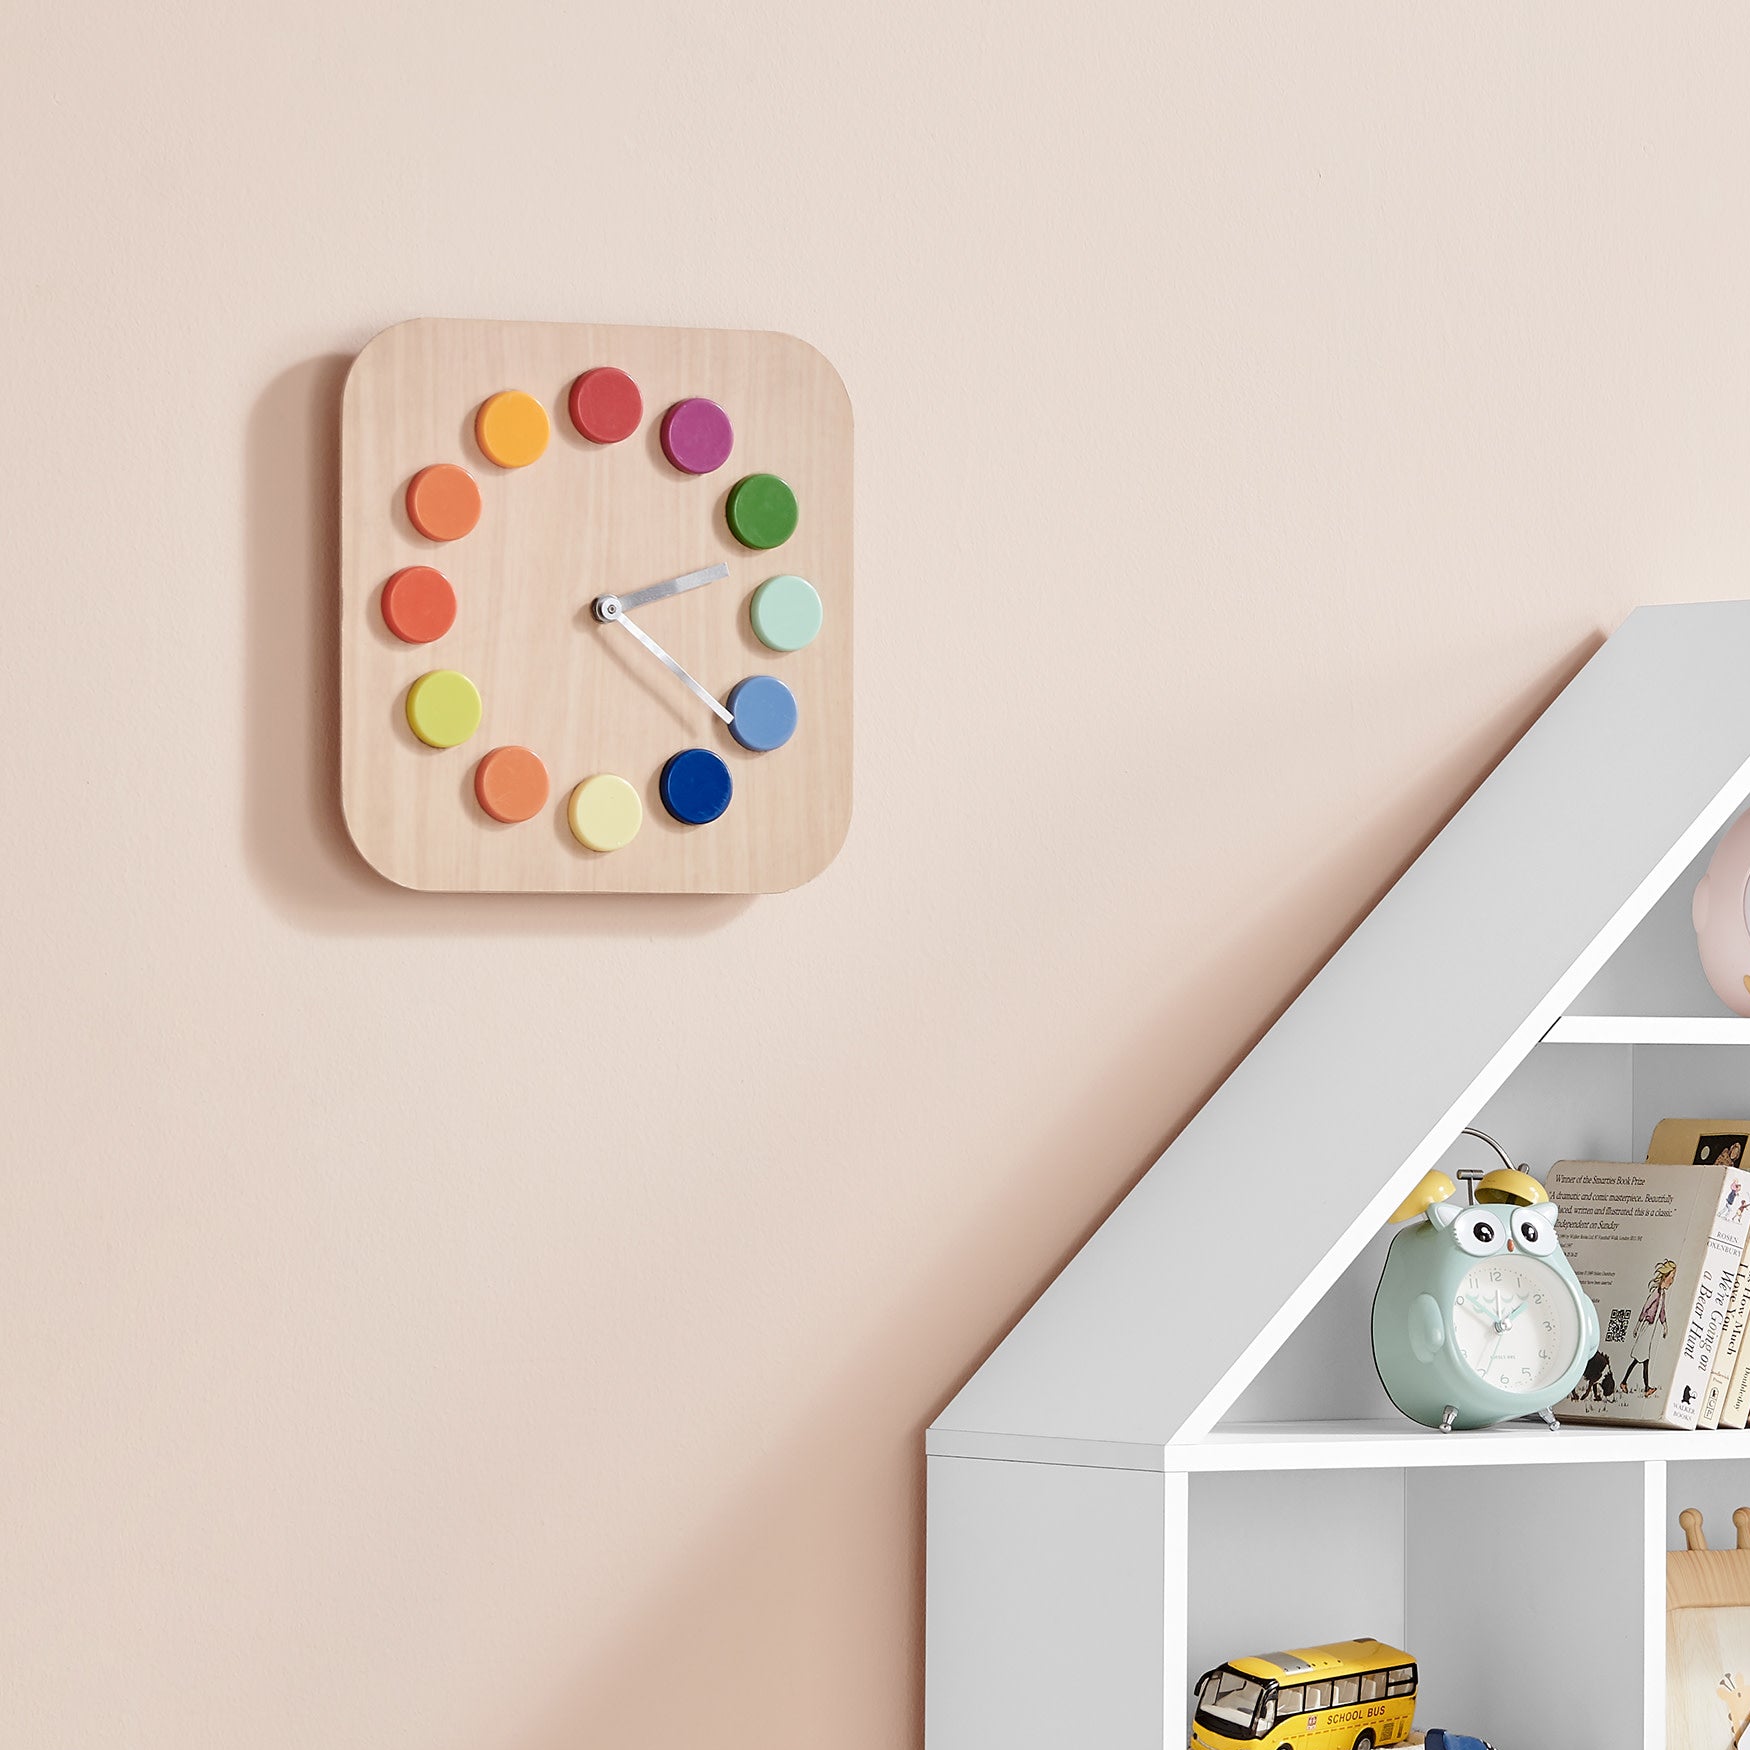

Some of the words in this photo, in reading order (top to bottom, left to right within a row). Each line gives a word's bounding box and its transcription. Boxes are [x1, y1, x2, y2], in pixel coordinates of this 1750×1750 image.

[1555, 1174, 1575, 1185] Winner
[1575, 1174, 1584, 1184] of
[1583, 1174, 1592, 1185] the
[1616, 1175, 1630, 1186] Book
[1631, 1175, 1646, 1186] Prize
[1556, 1190, 1581, 1201] dramatic
[1581, 1191, 1592, 1201] and
[1592, 1192, 1609, 1202] comic
[1594, 1206, 1605, 1216] and
[1589, 1221, 1598, 1230] on
[1598, 1219, 1620, 1232] Sunday
[1716, 1231, 1738, 1244] ROSEN
[1707, 1241, 1741, 1258] OXENBURY
[1489, 1271, 1502, 1282] 12
[1703, 1270, 1713, 1282] a
[1468, 1278, 1479, 1289] 11
[1715, 1269, 1735, 1307] We're
[1730, 1272, 1746, 1303] Love
[1533, 1293, 1542, 1304] 2
[1694, 1285, 1713, 1319] Bear
[1721, 1307, 1738, 1332] You
[1542, 1321, 1553, 1332] 3
[1699, 1310, 1723, 1350] Going
[1683, 1319, 1704, 1360] Hunt
[1726, 1320, 1743, 1356] Much
[1538, 1349, 1548, 1360] 4
[1697, 1354, 1709, 1372] on
[1521, 1367, 1531, 1378] 5
[1500, 1374, 1510, 1385] 6
[1673, 1402, 1695, 1415] WALKER
[1672, 1410, 1692, 1421] BOOKS
[1327, 1710, 1364, 1725] SCHOOL
[1367, 1705, 1386, 1717] BUS
